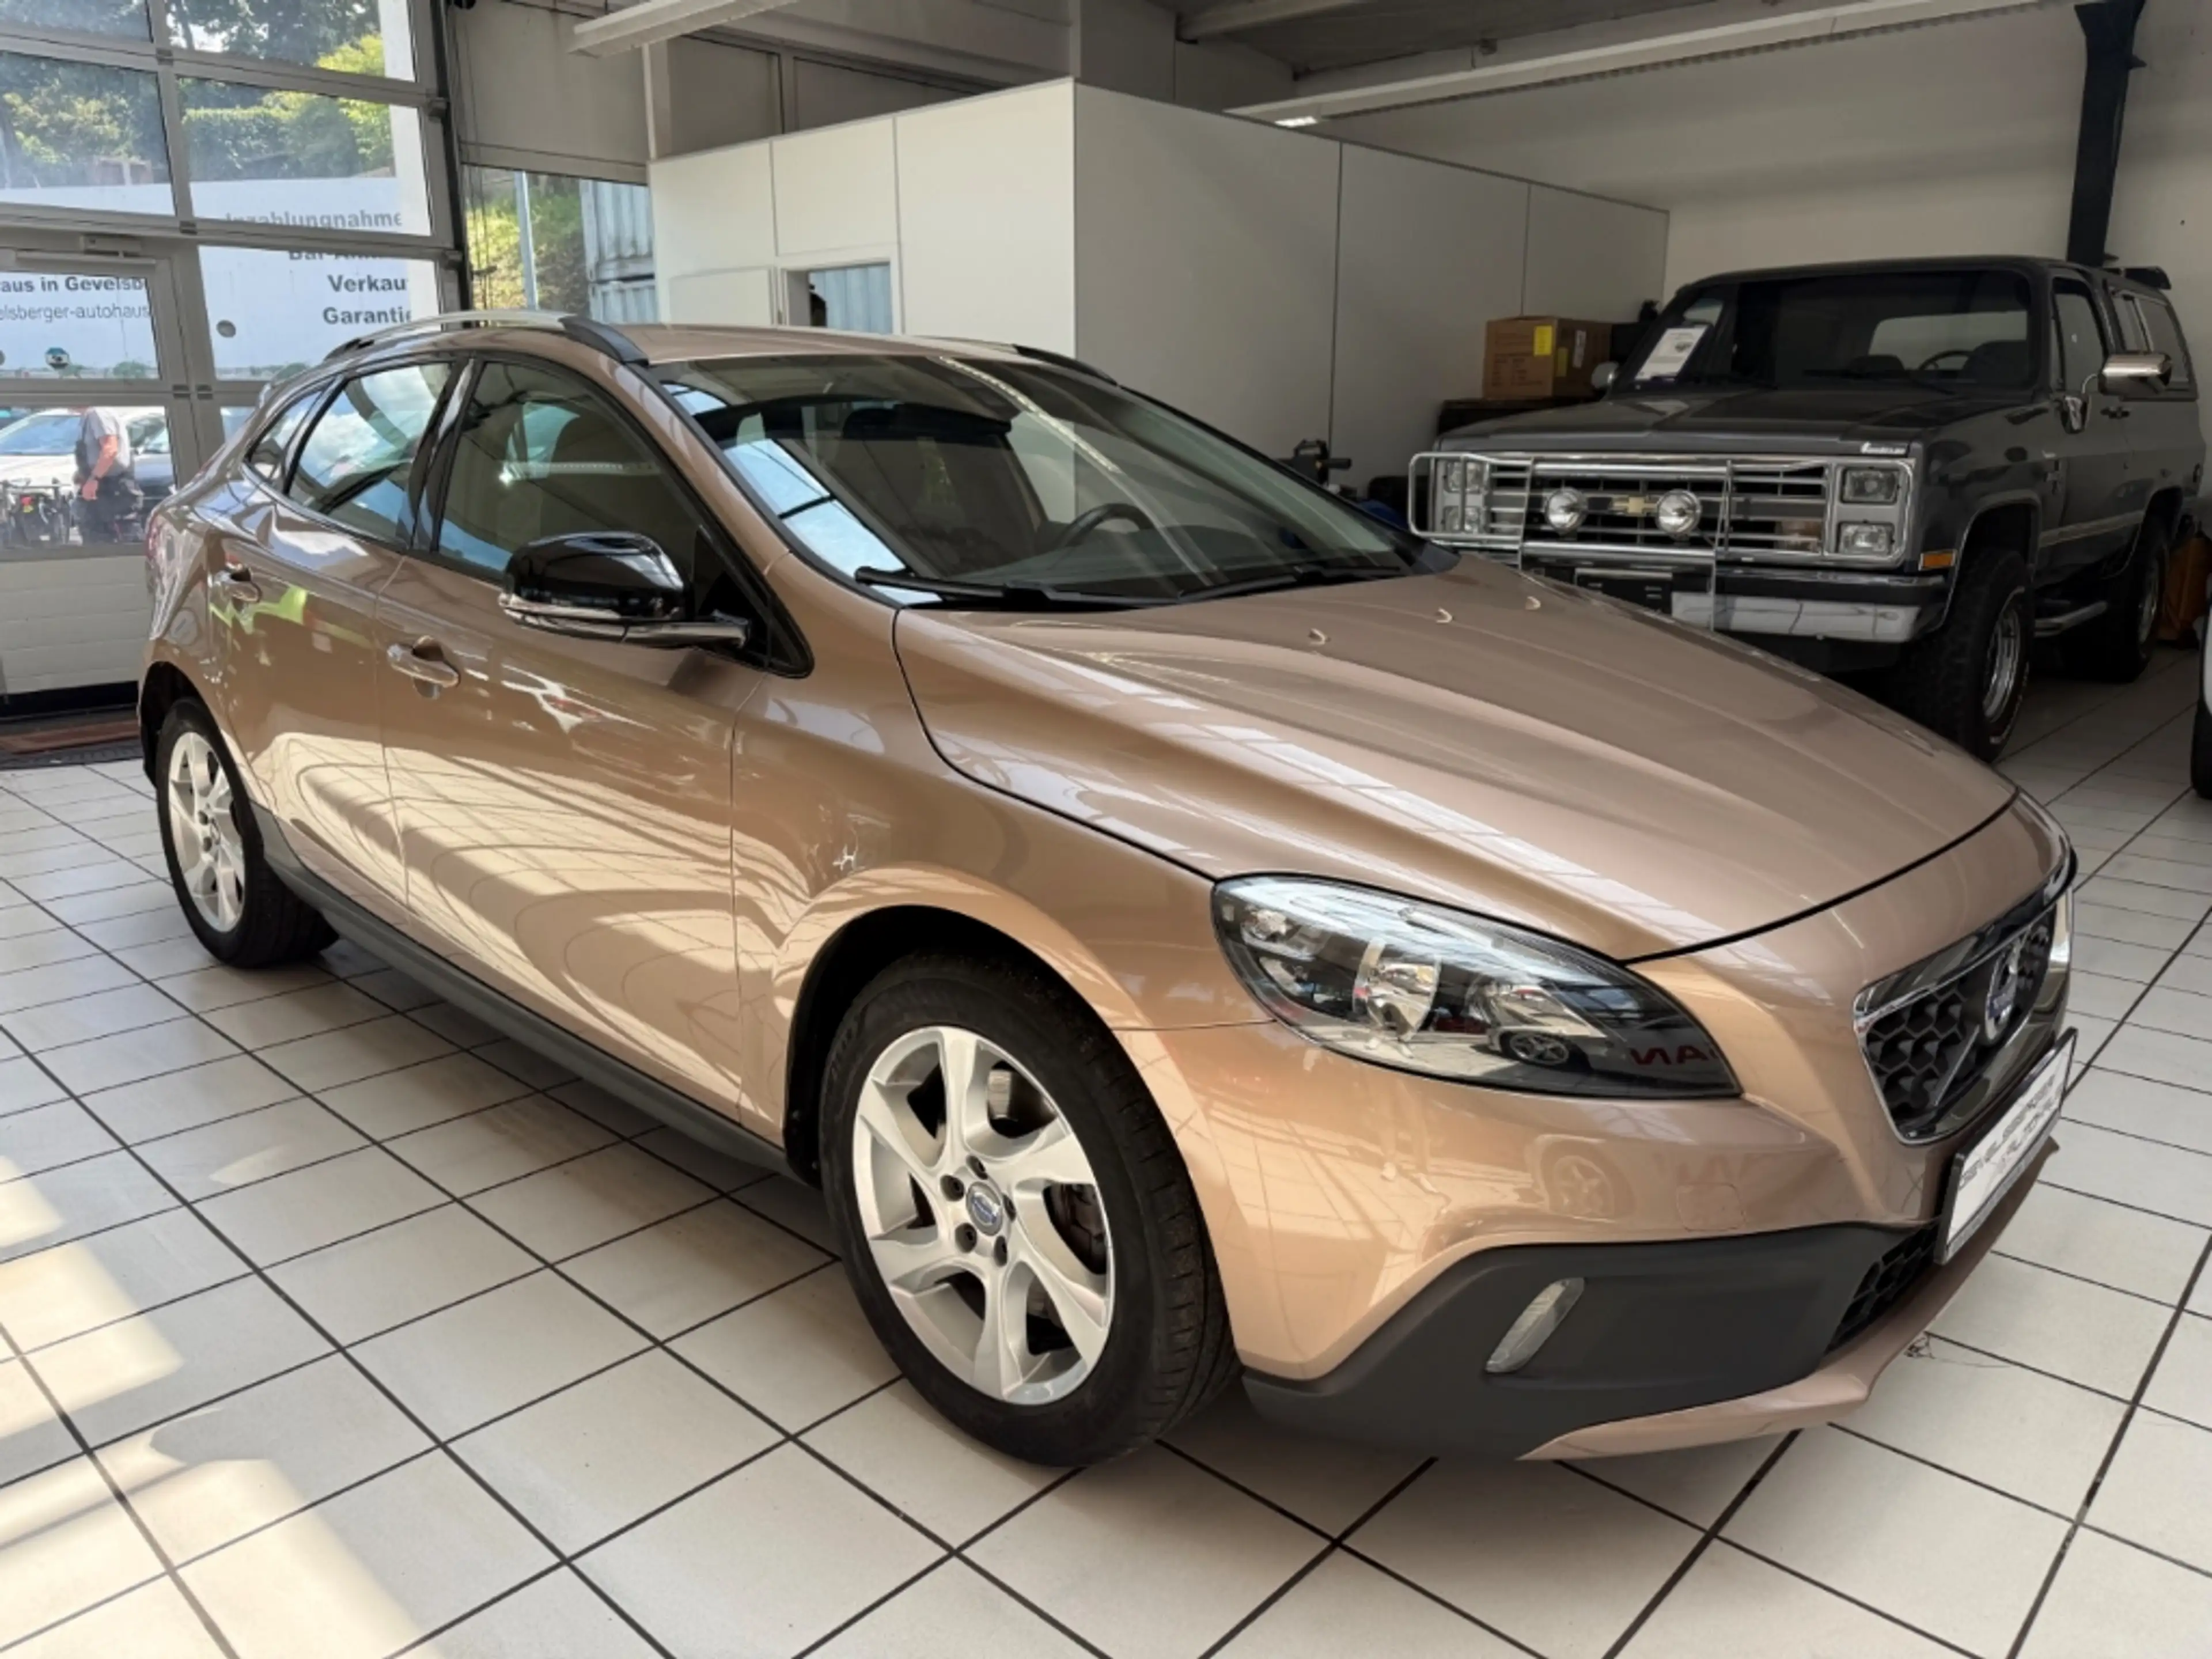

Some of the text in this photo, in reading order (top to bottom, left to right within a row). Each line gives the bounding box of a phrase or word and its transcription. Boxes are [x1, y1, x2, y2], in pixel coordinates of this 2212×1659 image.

[0, 280, 35, 293] aus
[41, 276, 58, 292] in
[327, 274, 408, 292] Verkau
